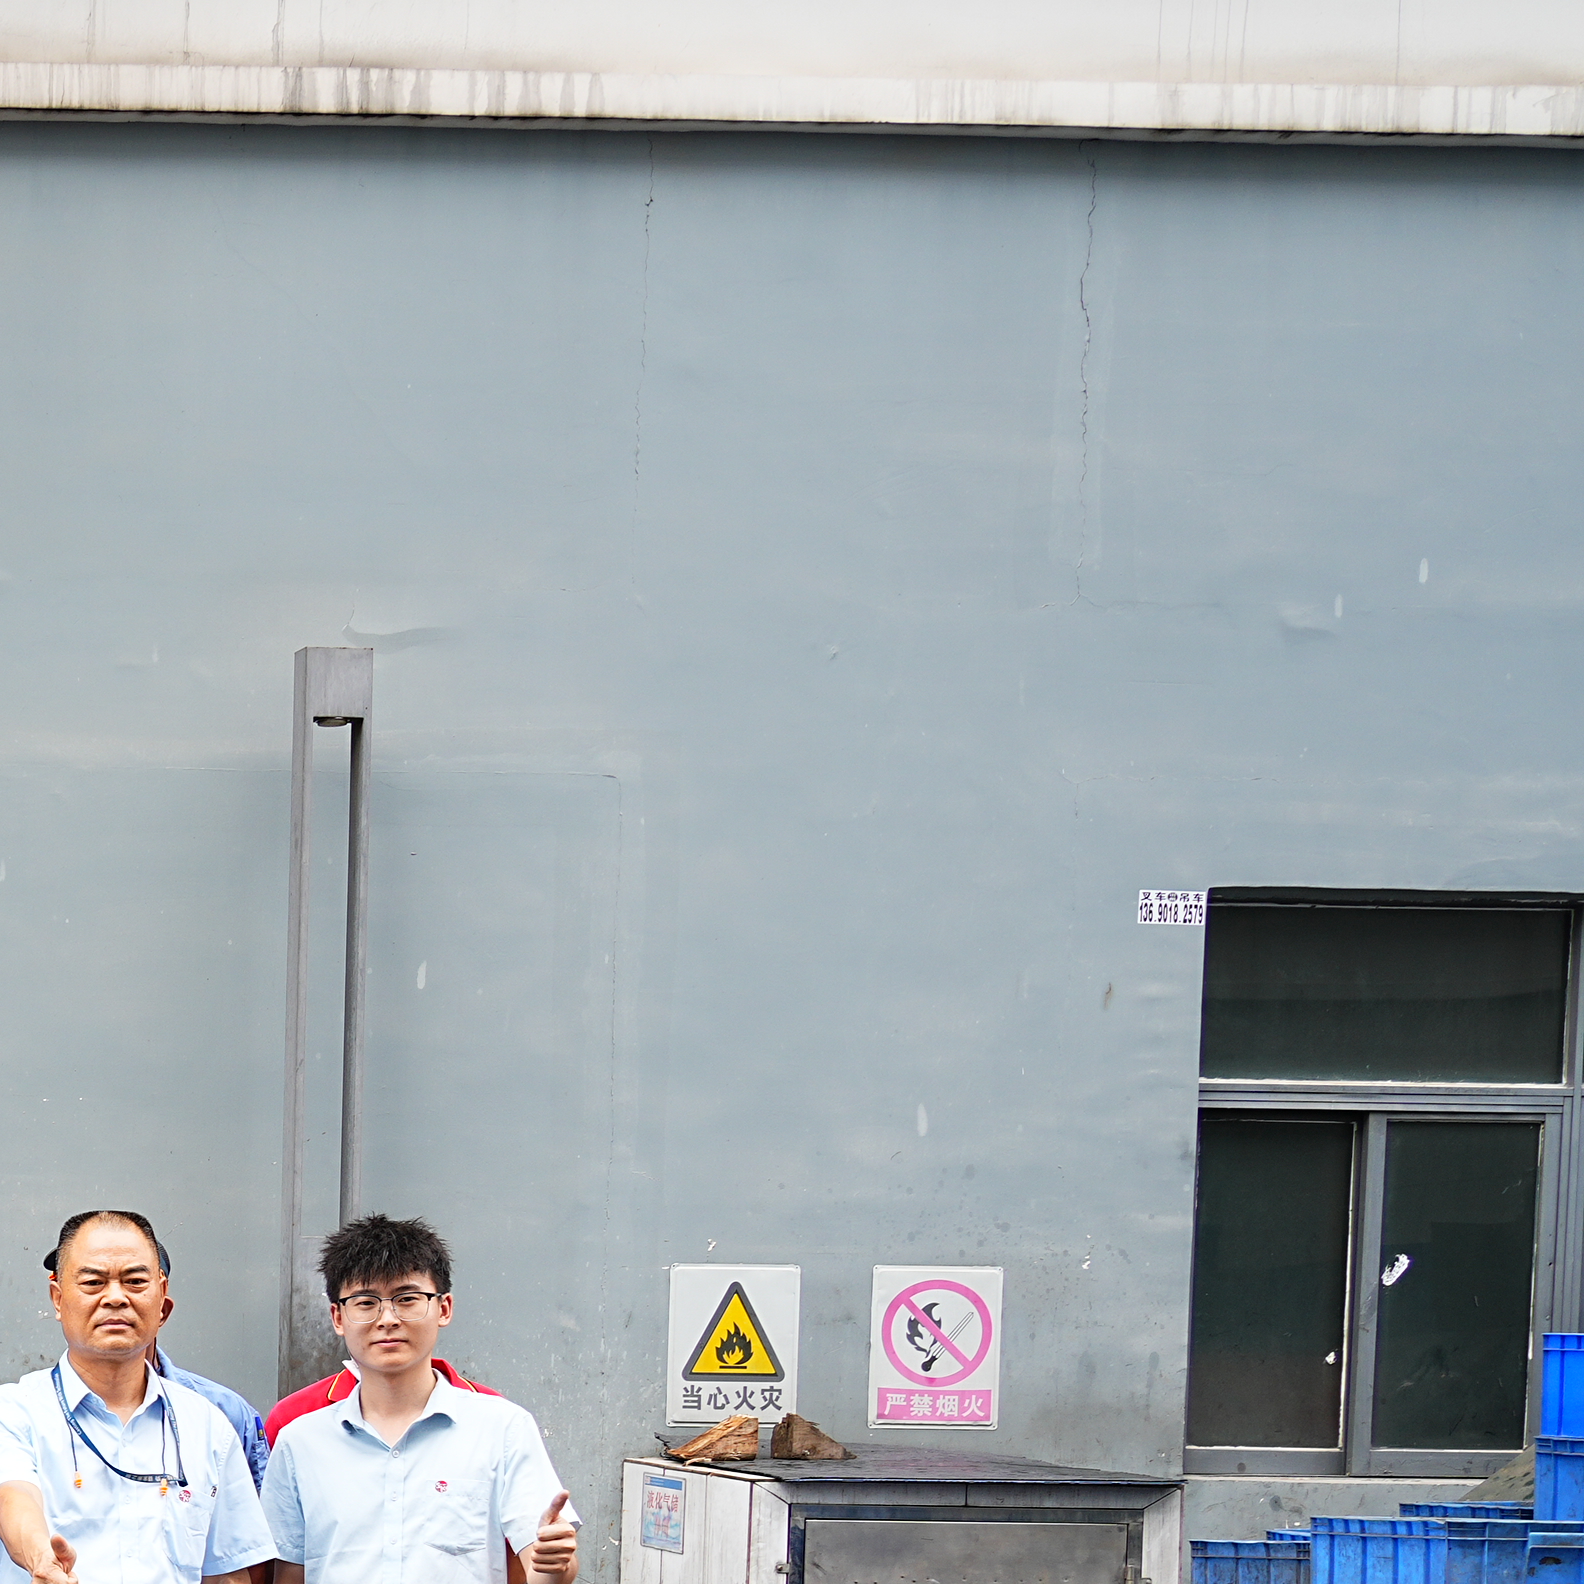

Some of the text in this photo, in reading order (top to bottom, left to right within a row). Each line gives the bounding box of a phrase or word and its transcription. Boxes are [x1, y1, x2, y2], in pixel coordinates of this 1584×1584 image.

[1139, 902, 1204, 924] 136.9018.2579
[681, 1384, 784, 1413] 当心火灾
[885, 1392, 986, 1418] 严禁烟火
